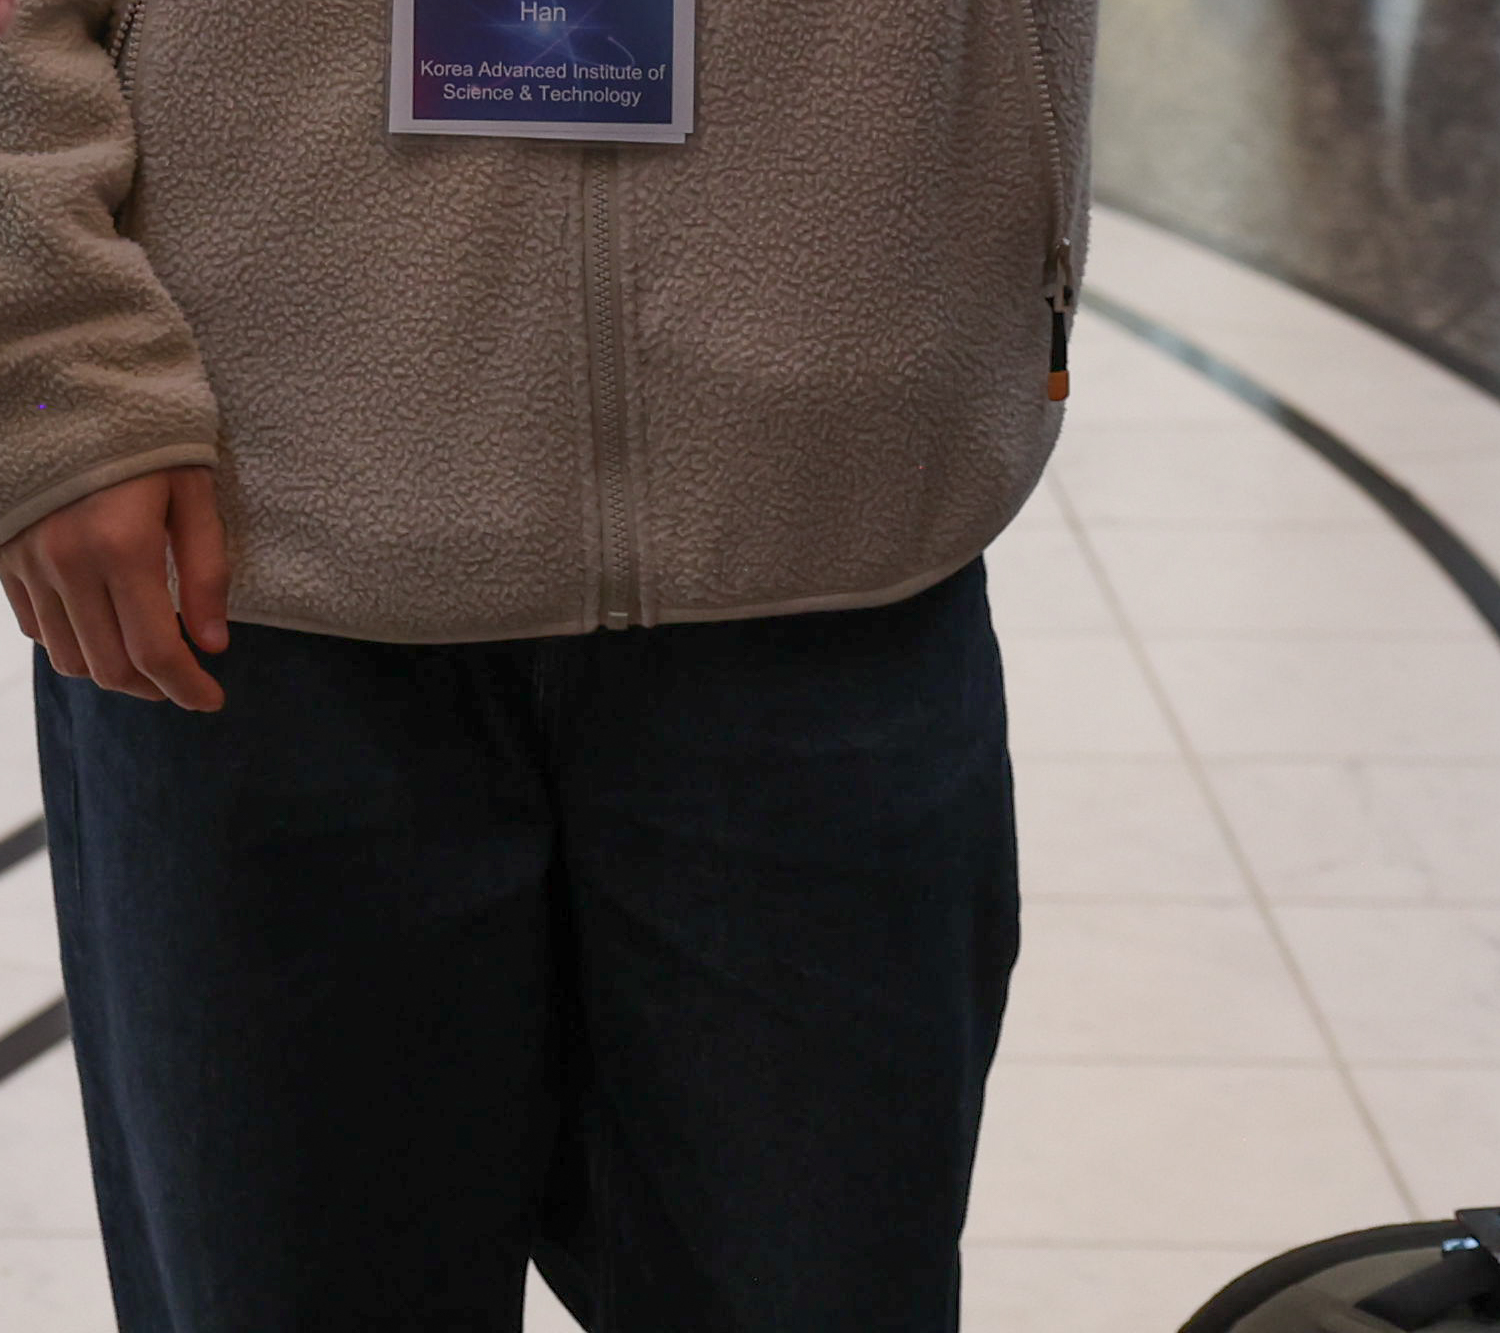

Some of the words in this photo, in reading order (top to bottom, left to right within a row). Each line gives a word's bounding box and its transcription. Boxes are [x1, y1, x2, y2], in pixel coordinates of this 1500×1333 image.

[520, 1, 567, 22] Han
[420, 61, 473, 78] Korea
[478, 62, 567, 80] Advanced
[573, 63, 643, 81] Institute
[648, 64, 667, 81] of
[443, 84, 514, 102] Science
[519, 86, 533, 101] &
[538, 85, 642, 108] Technology
